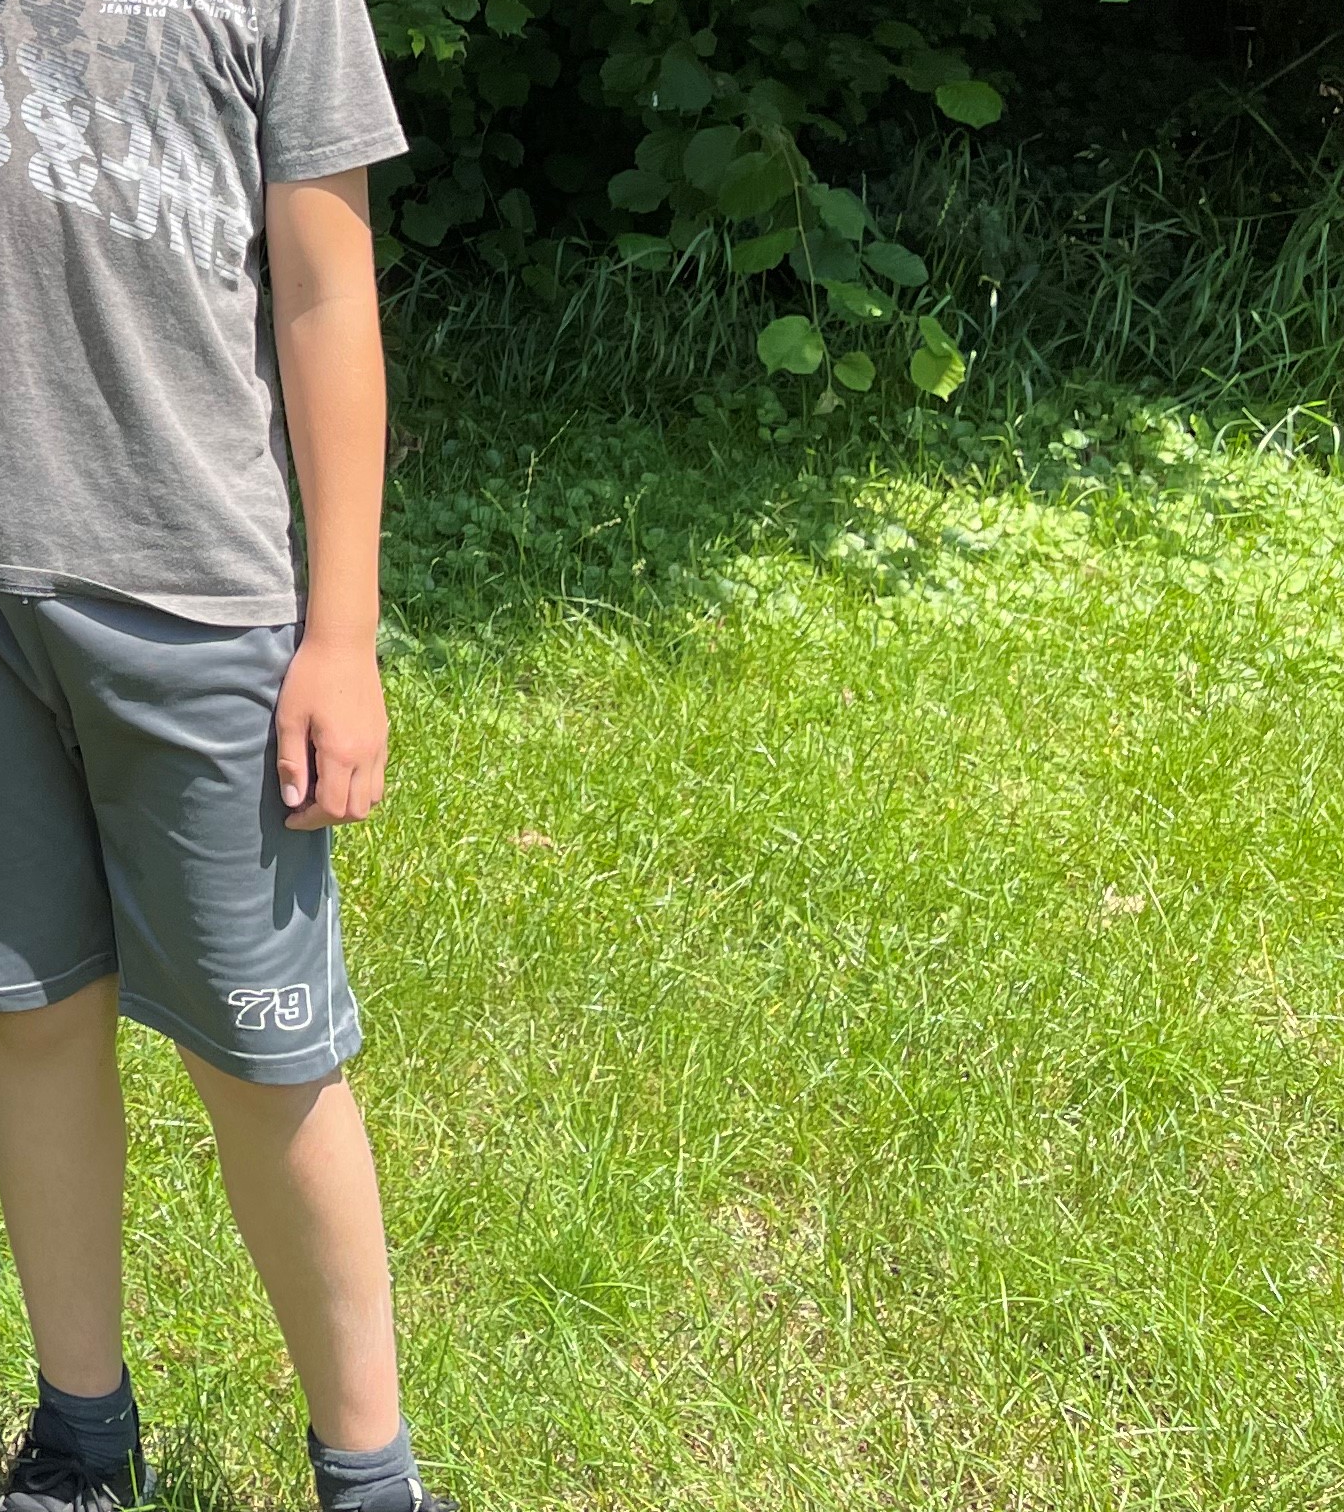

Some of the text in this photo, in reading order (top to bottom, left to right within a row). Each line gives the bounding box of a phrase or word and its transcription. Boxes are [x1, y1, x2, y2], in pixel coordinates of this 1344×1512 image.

[99, 3, 167, 18] JEANS Ltd
[227, 982, 313, 1031] 79
